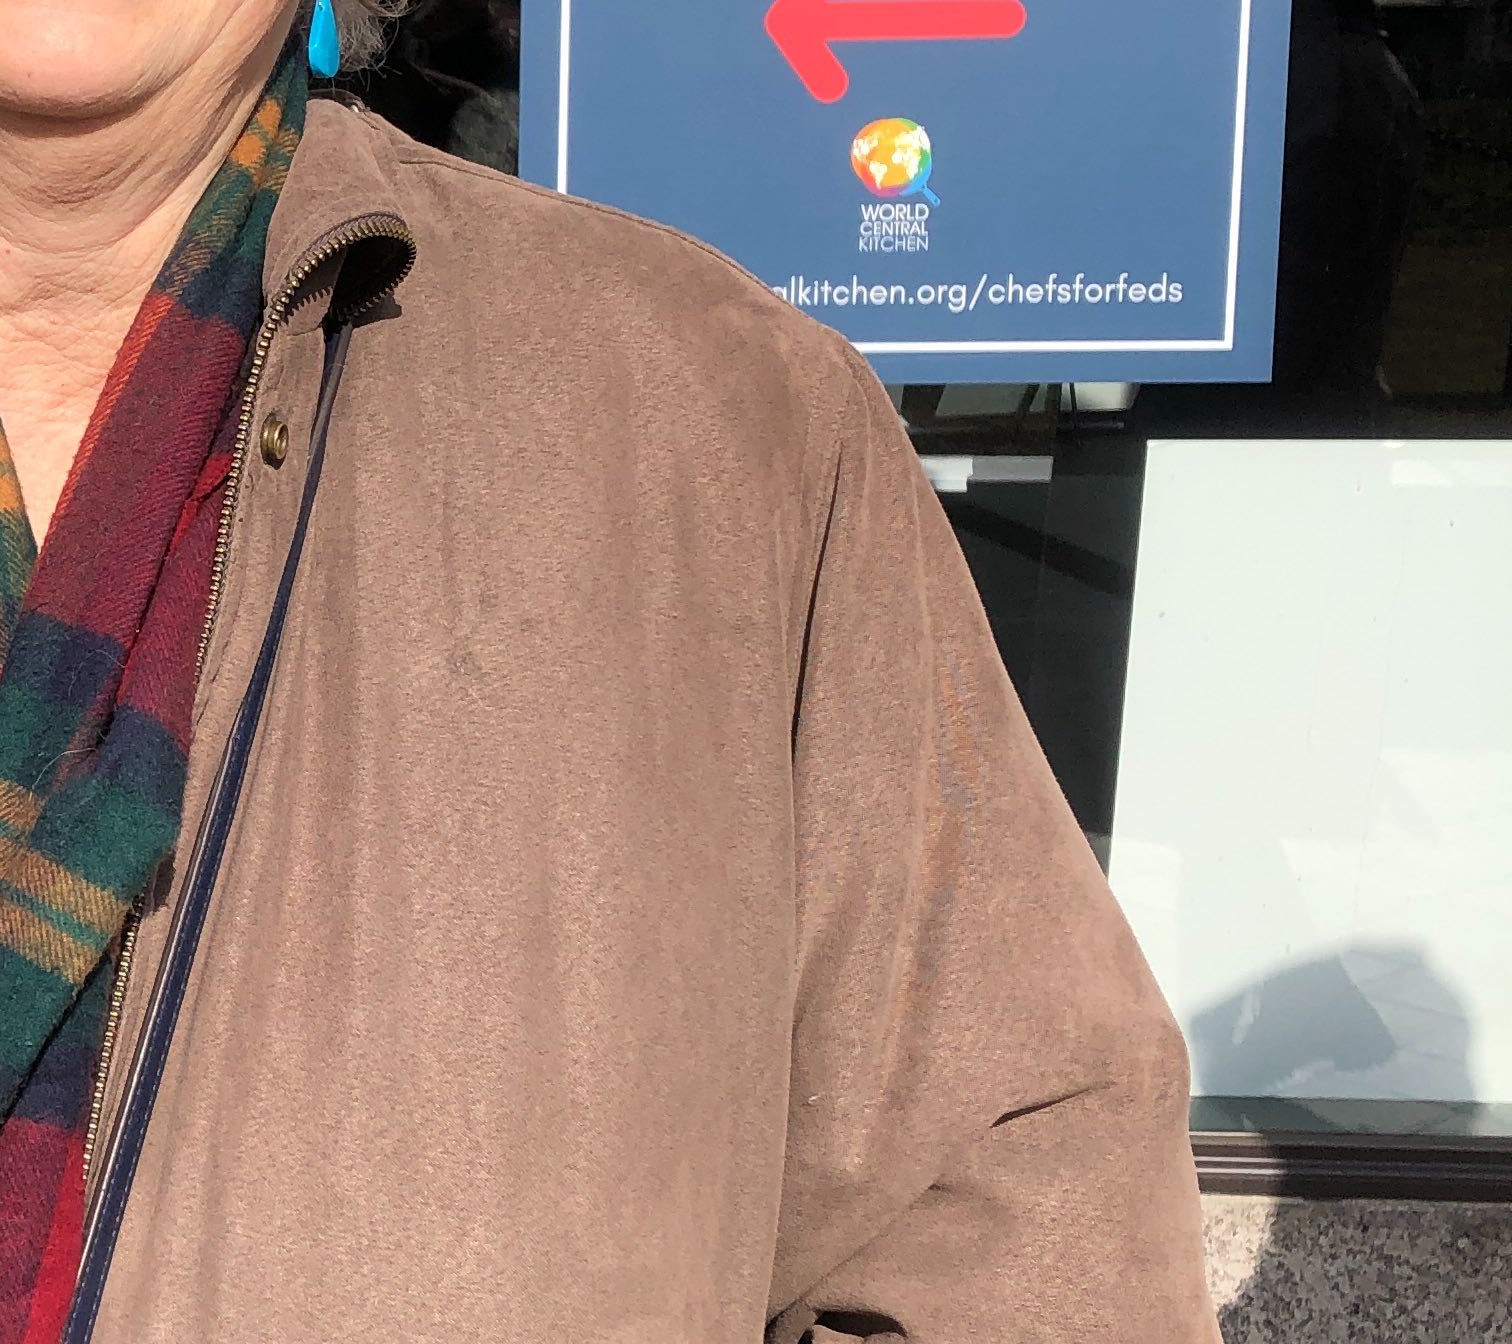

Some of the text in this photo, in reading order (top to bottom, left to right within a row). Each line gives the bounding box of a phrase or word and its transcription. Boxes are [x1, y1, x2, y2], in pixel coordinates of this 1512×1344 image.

[860, 203, 929, 221] WORLD
[859, 220, 929, 236] CENTRAL
[858, 236, 929, 253] KITCHEN
